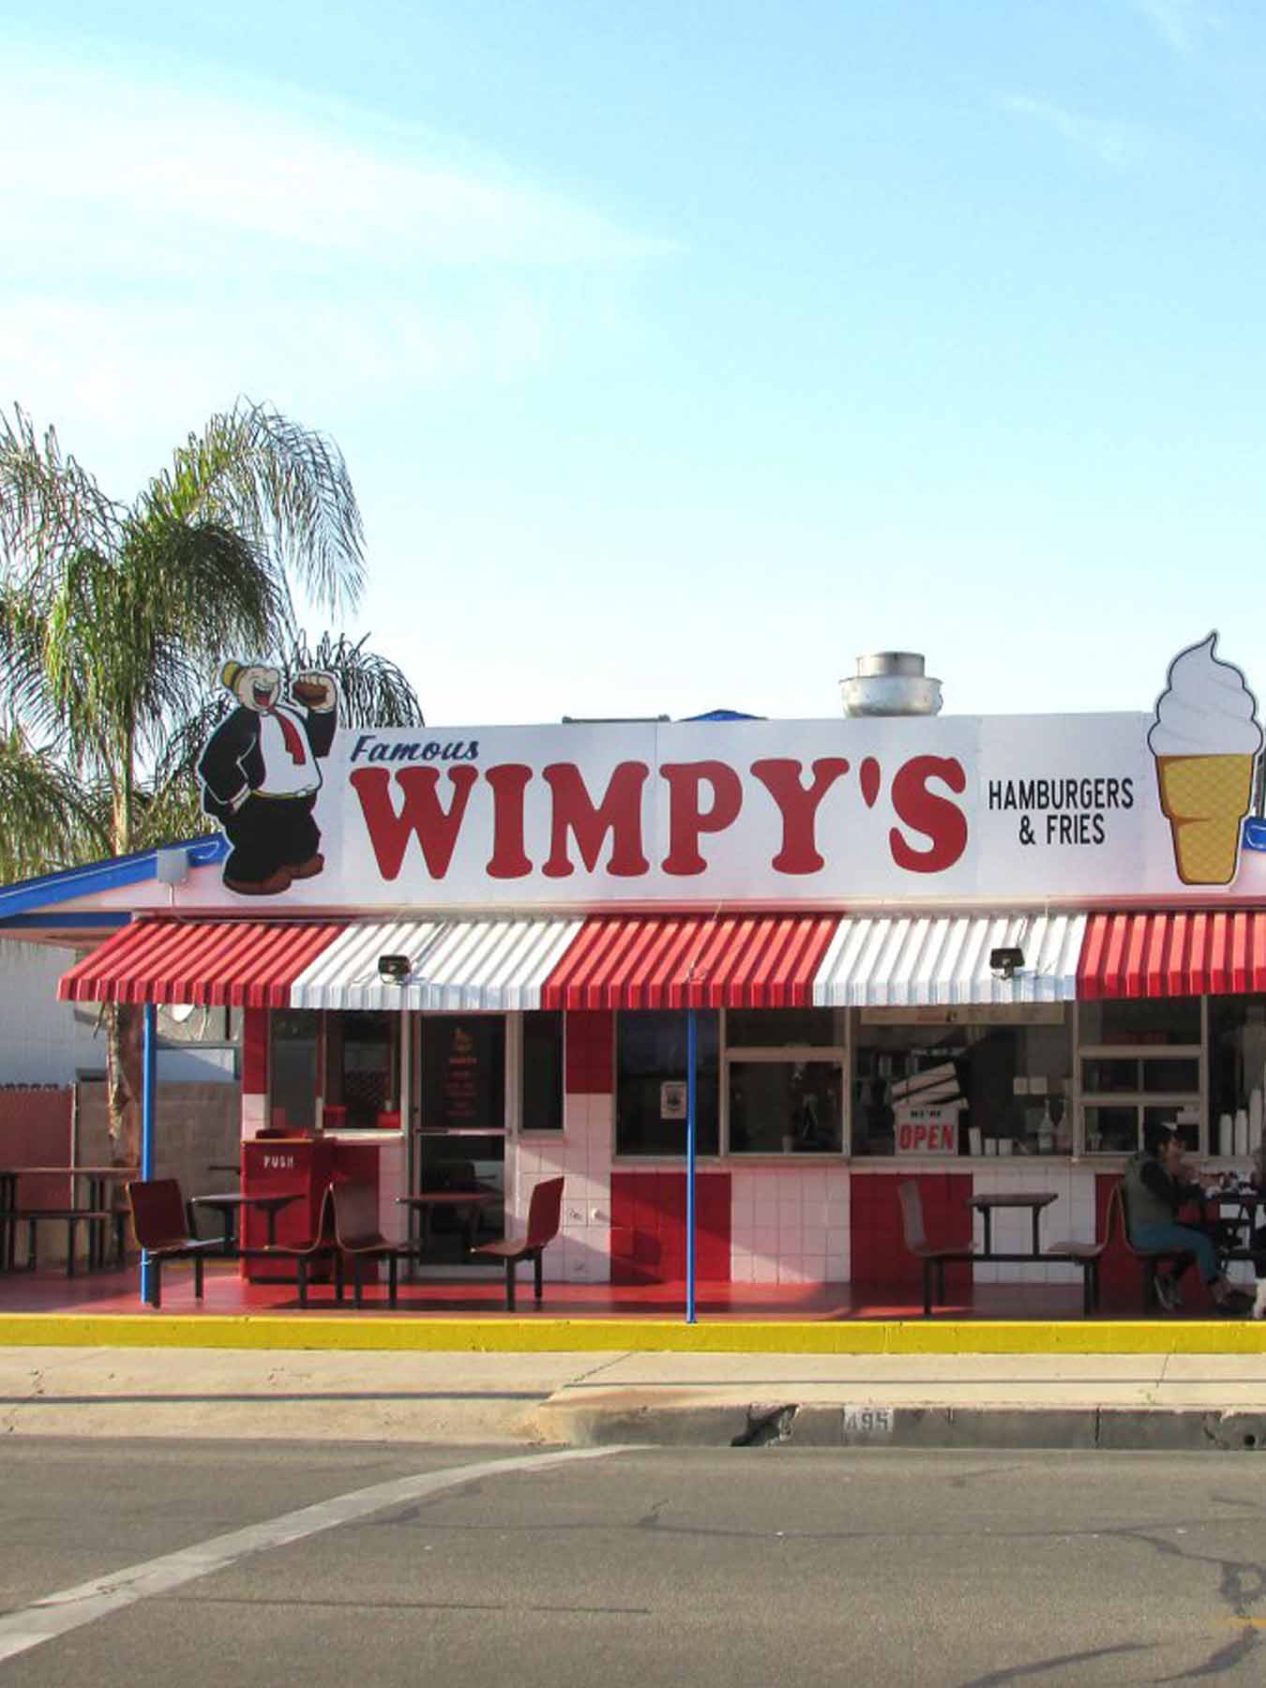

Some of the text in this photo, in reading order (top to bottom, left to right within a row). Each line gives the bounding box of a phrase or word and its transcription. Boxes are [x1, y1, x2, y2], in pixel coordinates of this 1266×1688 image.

[350, 735, 479, 762] Famous
[988, 777, 1134, 811] HAMBURGERS
[349, 754, 968, 881] WIMPY'S
[1018, 813, 1105, 846] & FRIES
[899, 1123, 955, 1151] OPEN
[263, 1154, 295, 1169] PUSH
[846, 1410, 889, 1430] 495
